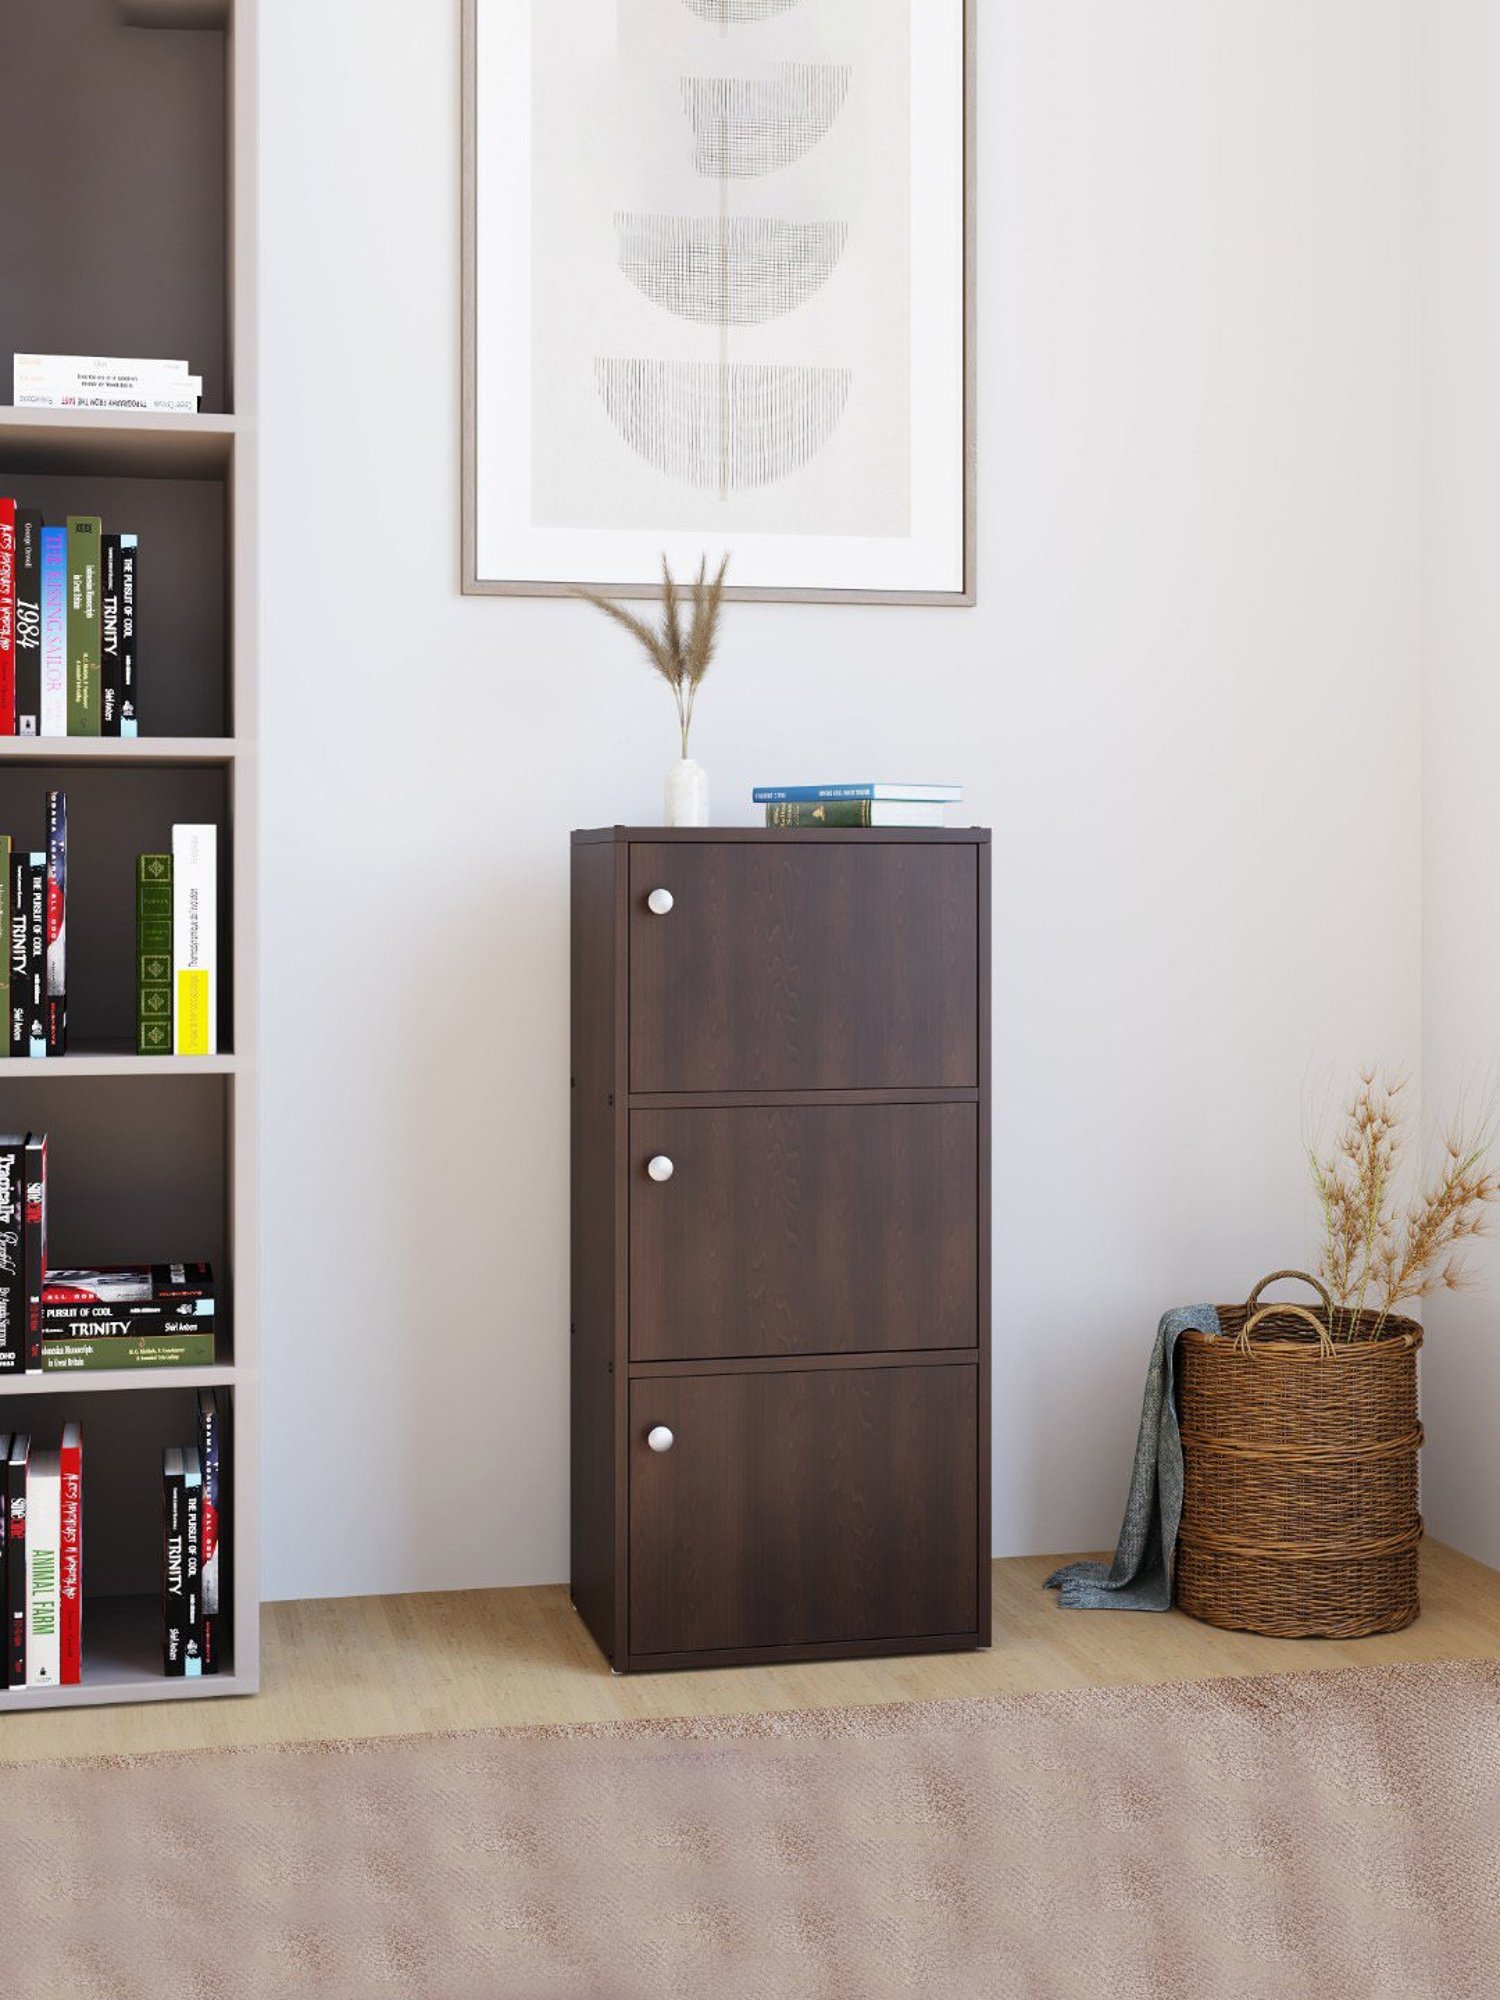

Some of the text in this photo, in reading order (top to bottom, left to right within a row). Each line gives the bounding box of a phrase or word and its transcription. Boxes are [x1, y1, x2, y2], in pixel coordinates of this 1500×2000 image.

[61, 396, 76, 405] EAST
[77, 397, 89, 406] THE
[24, 523, 34, 568] George Orwell
[46, 535, 63, 566] THE
[16, 598, 40, 648] 1984
[46, 571, 63, 631] KISSING
[103, 595, 118, 656] TRINITY
[123, 558, 133, 639] THE PURSUIT OF COOL
[46, 634, 63, 692] SAILOR
[12, 914, 27, 976] TRINITY
[32, 877, 43, 957] THE PURSUIT OF COOL
[0, 1154, 15, 1224] Tragically
[46, 1307, 113, 1318] PURSUIT OF COOL
[69, 1320, 132, 1336] TRINITY
[164, 1322, 178, 1333] Shirl
[168, 1534, 182, 1595] TRINITY
[188, 1497, 198, 1578] THE PURSUIT OF COOL
[32, 1549, 55, 1636] ANIMAL FARM
